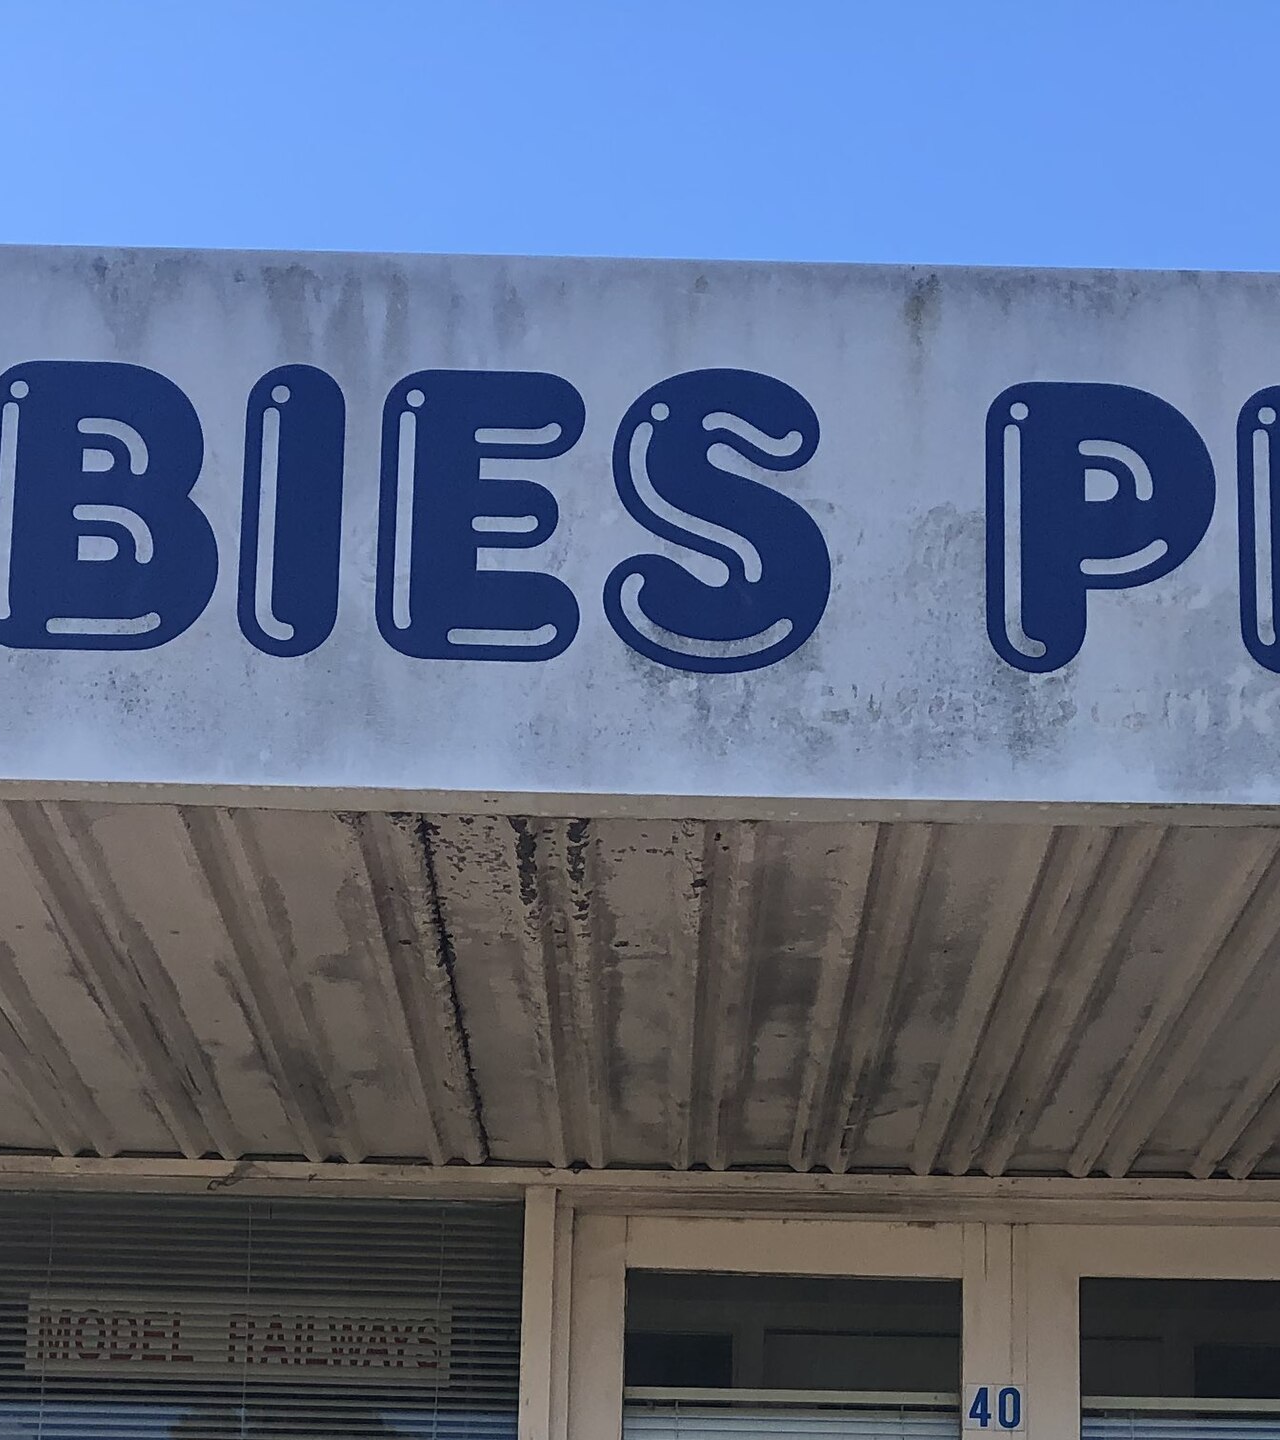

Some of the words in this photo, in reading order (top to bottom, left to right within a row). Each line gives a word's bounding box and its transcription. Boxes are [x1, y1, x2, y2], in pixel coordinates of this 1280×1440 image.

[37, 1309, 194, 1361] MODEL
[228, 1314, 443, 1367] RAILWAYS
[969, 1386, 1022, 1430] 40
